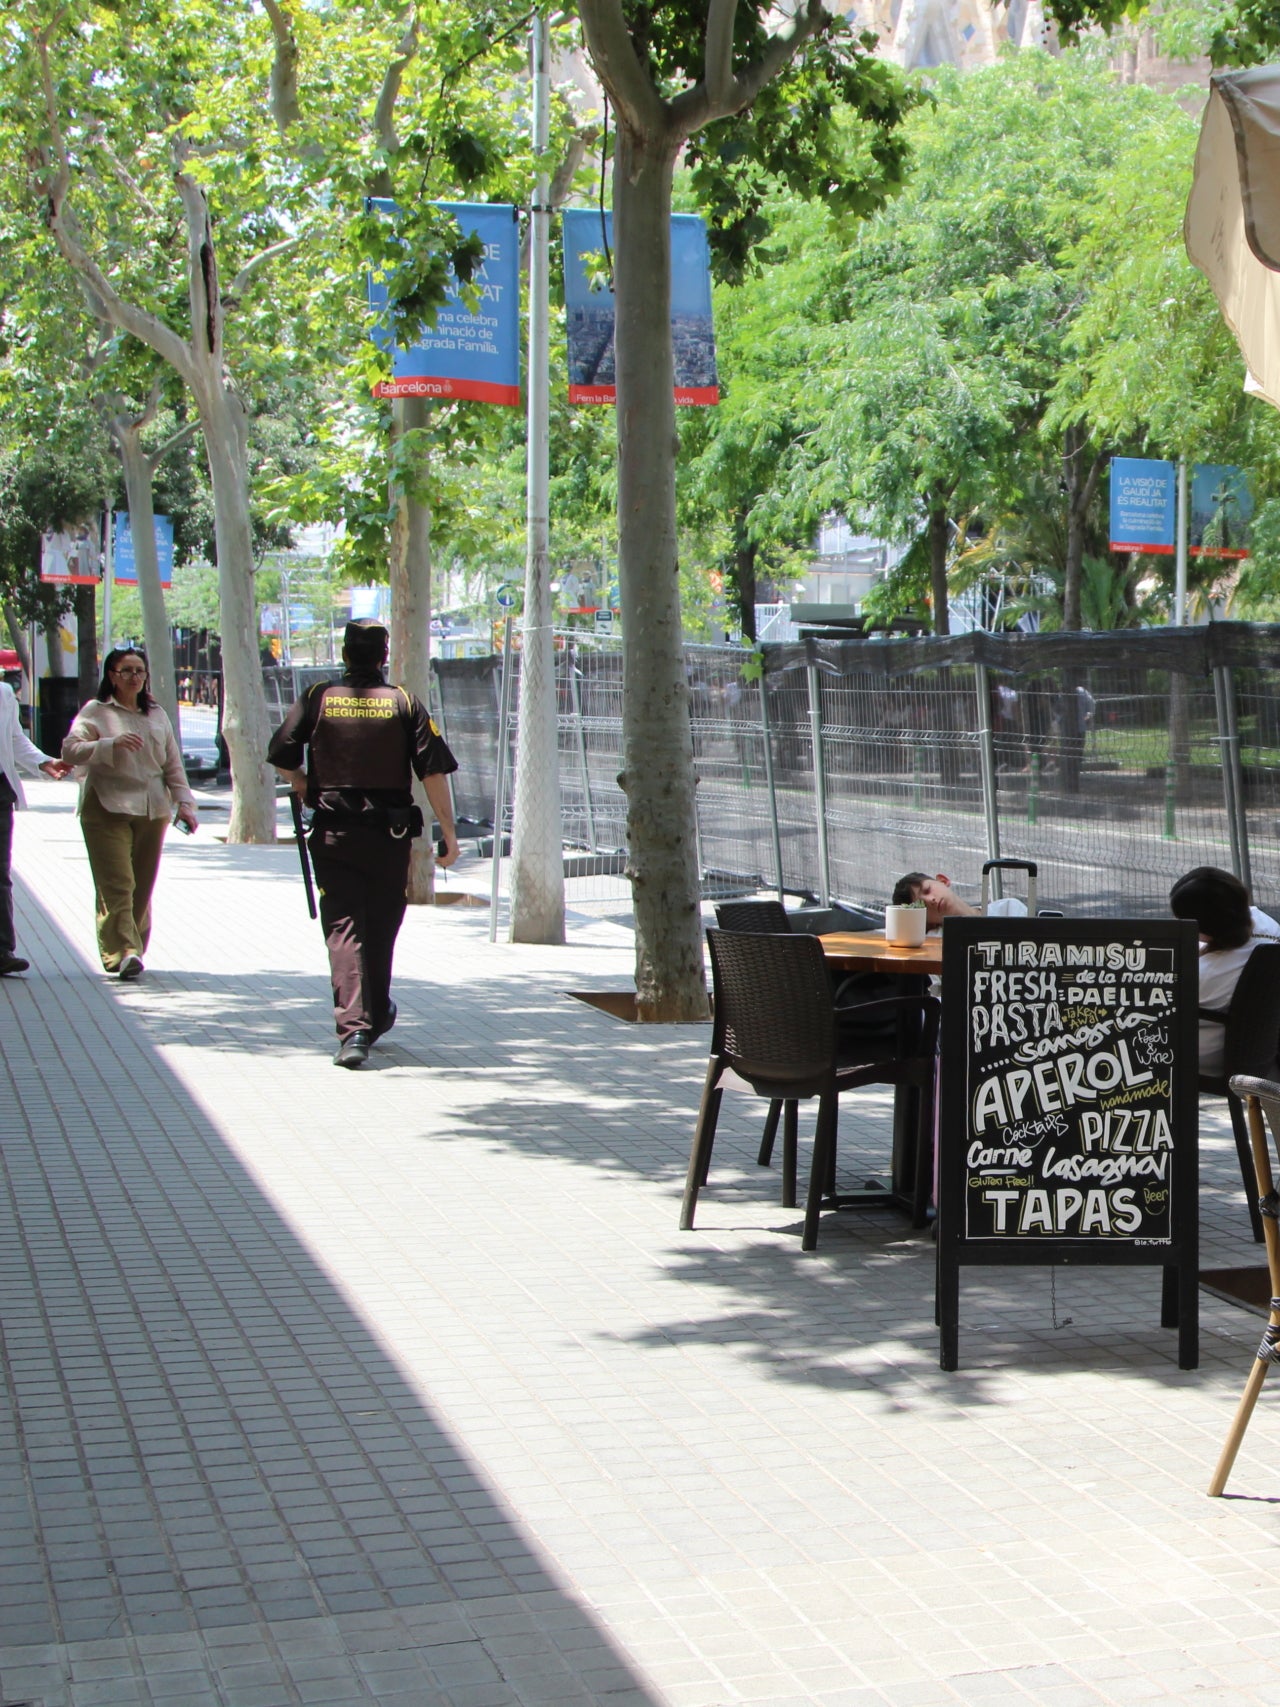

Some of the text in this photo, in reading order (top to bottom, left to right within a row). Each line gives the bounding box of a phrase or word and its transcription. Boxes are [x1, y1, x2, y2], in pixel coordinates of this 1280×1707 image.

[456, 311, 498, 328] celebra
[478, 327, 494, 340] de
[380, 381, 443, 395] Barcelona
[1120, 477, 1131, 486] LA
[1156, 480, 1168, 488] DE
[1152, 489, 1162, 497] JA
[325, 696, 393, 708] PROSEGUR
[325, 708, 393, 718] SEGURIDAD
[977, 940, 1146, 971] TIRAMISÚ
[1075, 969, 1174, 985] de la nonna
[974, 970, 1058, 1004] FRESH
[1067, 986, 1169, 1007] PAELLA
[972, 1002, 1064, 1054] PASTA
[974, 1039, 1154, 1133] APEROL
[1100, 1078, 1172, 1111] handmade
[1081, 1108, 1175, 1152] PIZZA
[966, 1140, 1033, 1169] Carne
[1143, 1187, 1169, 1205] Beer
[985, 1187, 1143, 1232] TAPAS
